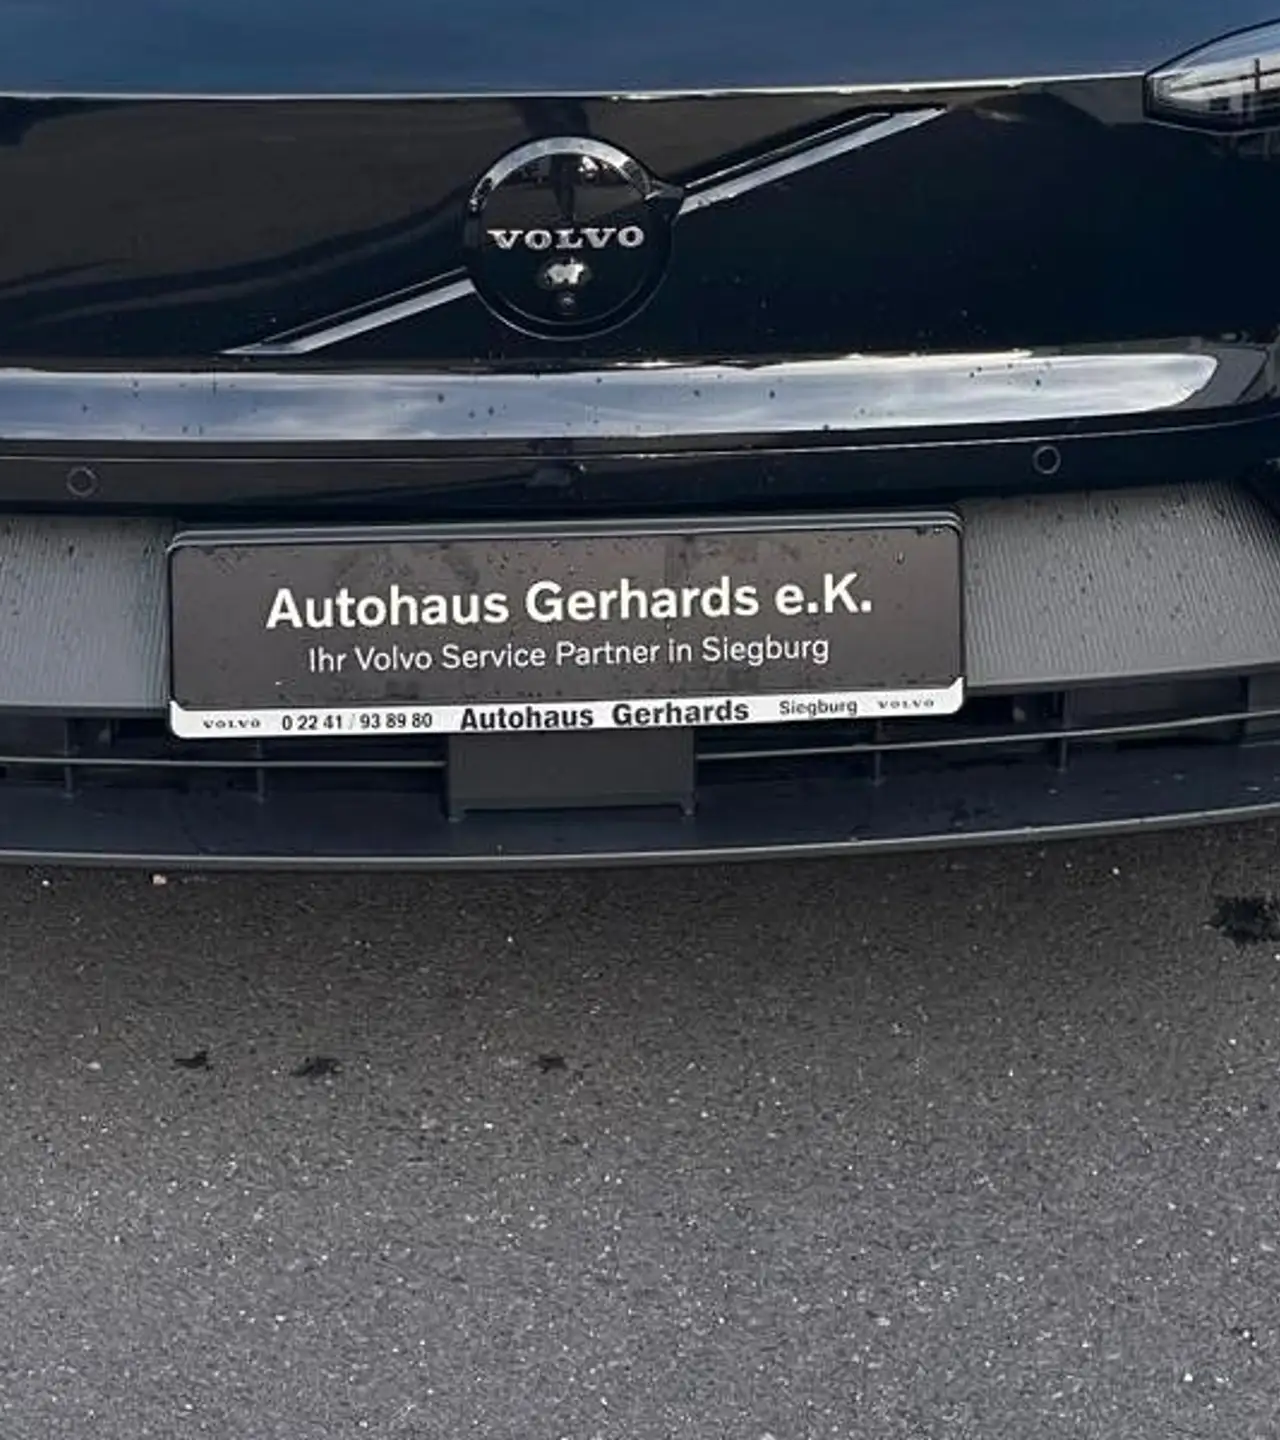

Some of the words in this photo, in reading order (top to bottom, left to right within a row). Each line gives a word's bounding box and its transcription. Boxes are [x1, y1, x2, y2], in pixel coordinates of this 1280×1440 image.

[487, 225, 645, 250] VOLVO
[265, 584, 509, 629] Autohaus
[525, 576, 759, 622] Gerhards
[774, 572, 872, 616] e.K.
[309, 647, 347, 673] Ihr
[354, 645, 433, 672] Volvo
[441, 642, 546, 669] Service
[555, 639, 660, 667] Partner
[668, 638, 693, 663] in
[701, 635, 830, 666] Siegburg
[202, 718, 261, 730] VOLVO
[282, 714, 293, 731] 0
[296, 714, 318, 731] 22
[322, 713, 342, 730] 41
[359, 712, 381, 730] 93
[385, 712, 407, 729] 89
[411, 712, 433, 729] 80
[459, 706, 594, 732] Autohaus
[611, 699, 751, 727] Gerhards
[778, 699, 858, 717] Siegburg
[877, 699, 935, 710] VOLVO
